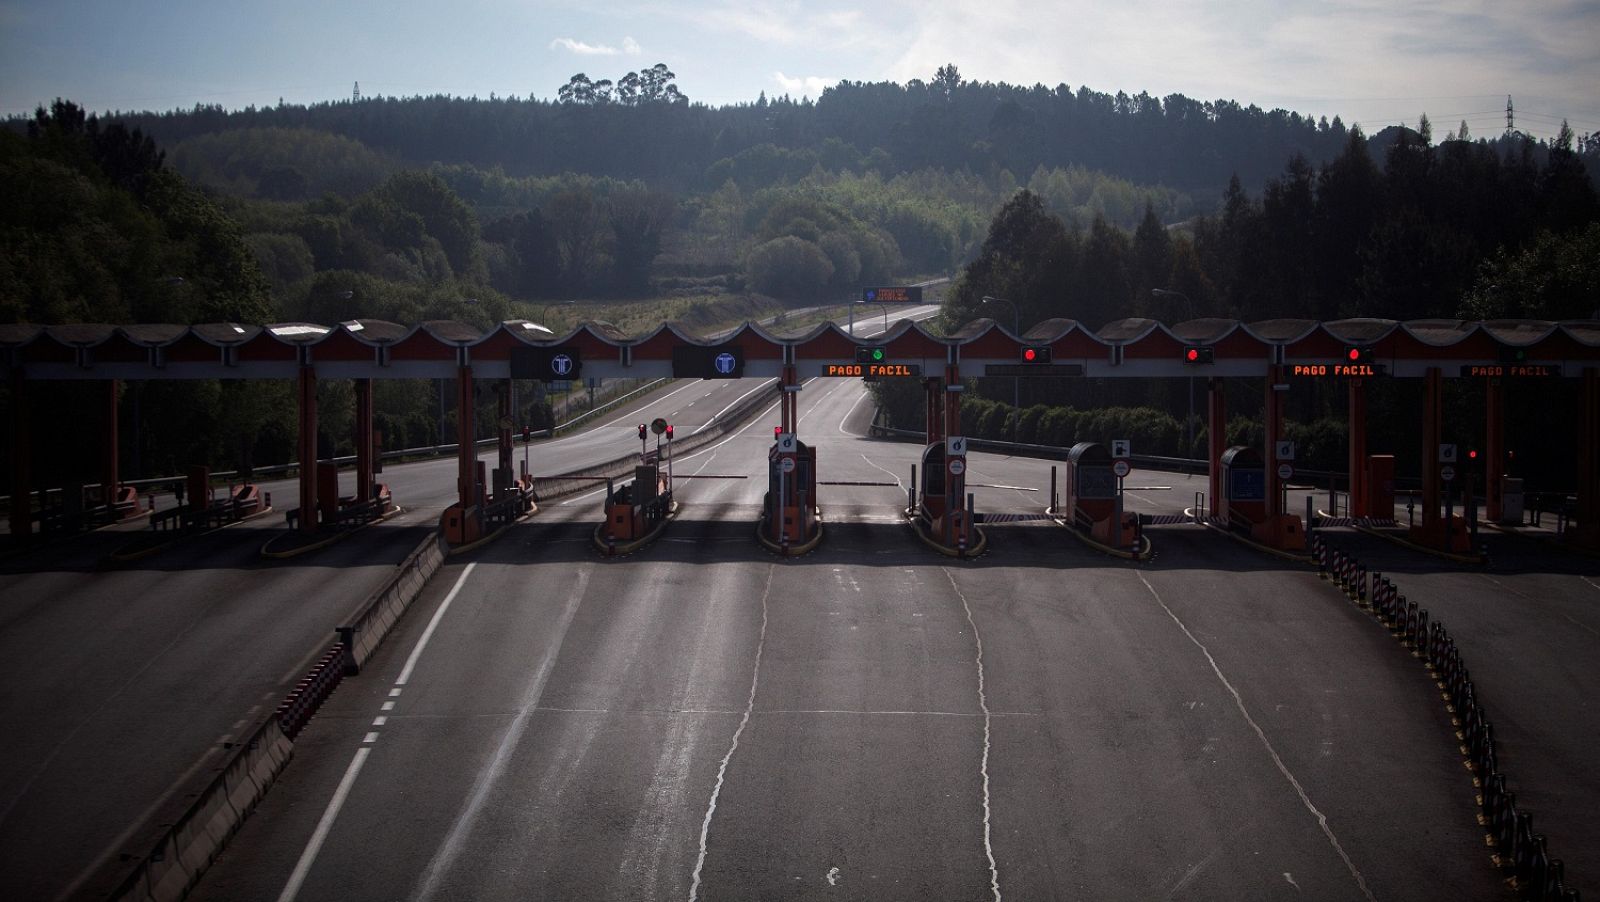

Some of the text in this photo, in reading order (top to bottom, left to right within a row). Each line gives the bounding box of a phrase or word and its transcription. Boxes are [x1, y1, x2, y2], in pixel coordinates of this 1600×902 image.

[829, 366, 910, 375] PAGO FACIL
[1295, 366, 1374, 375] PAGO FACIL
[1472, 366, 1549, 376] PAGO FACIL
